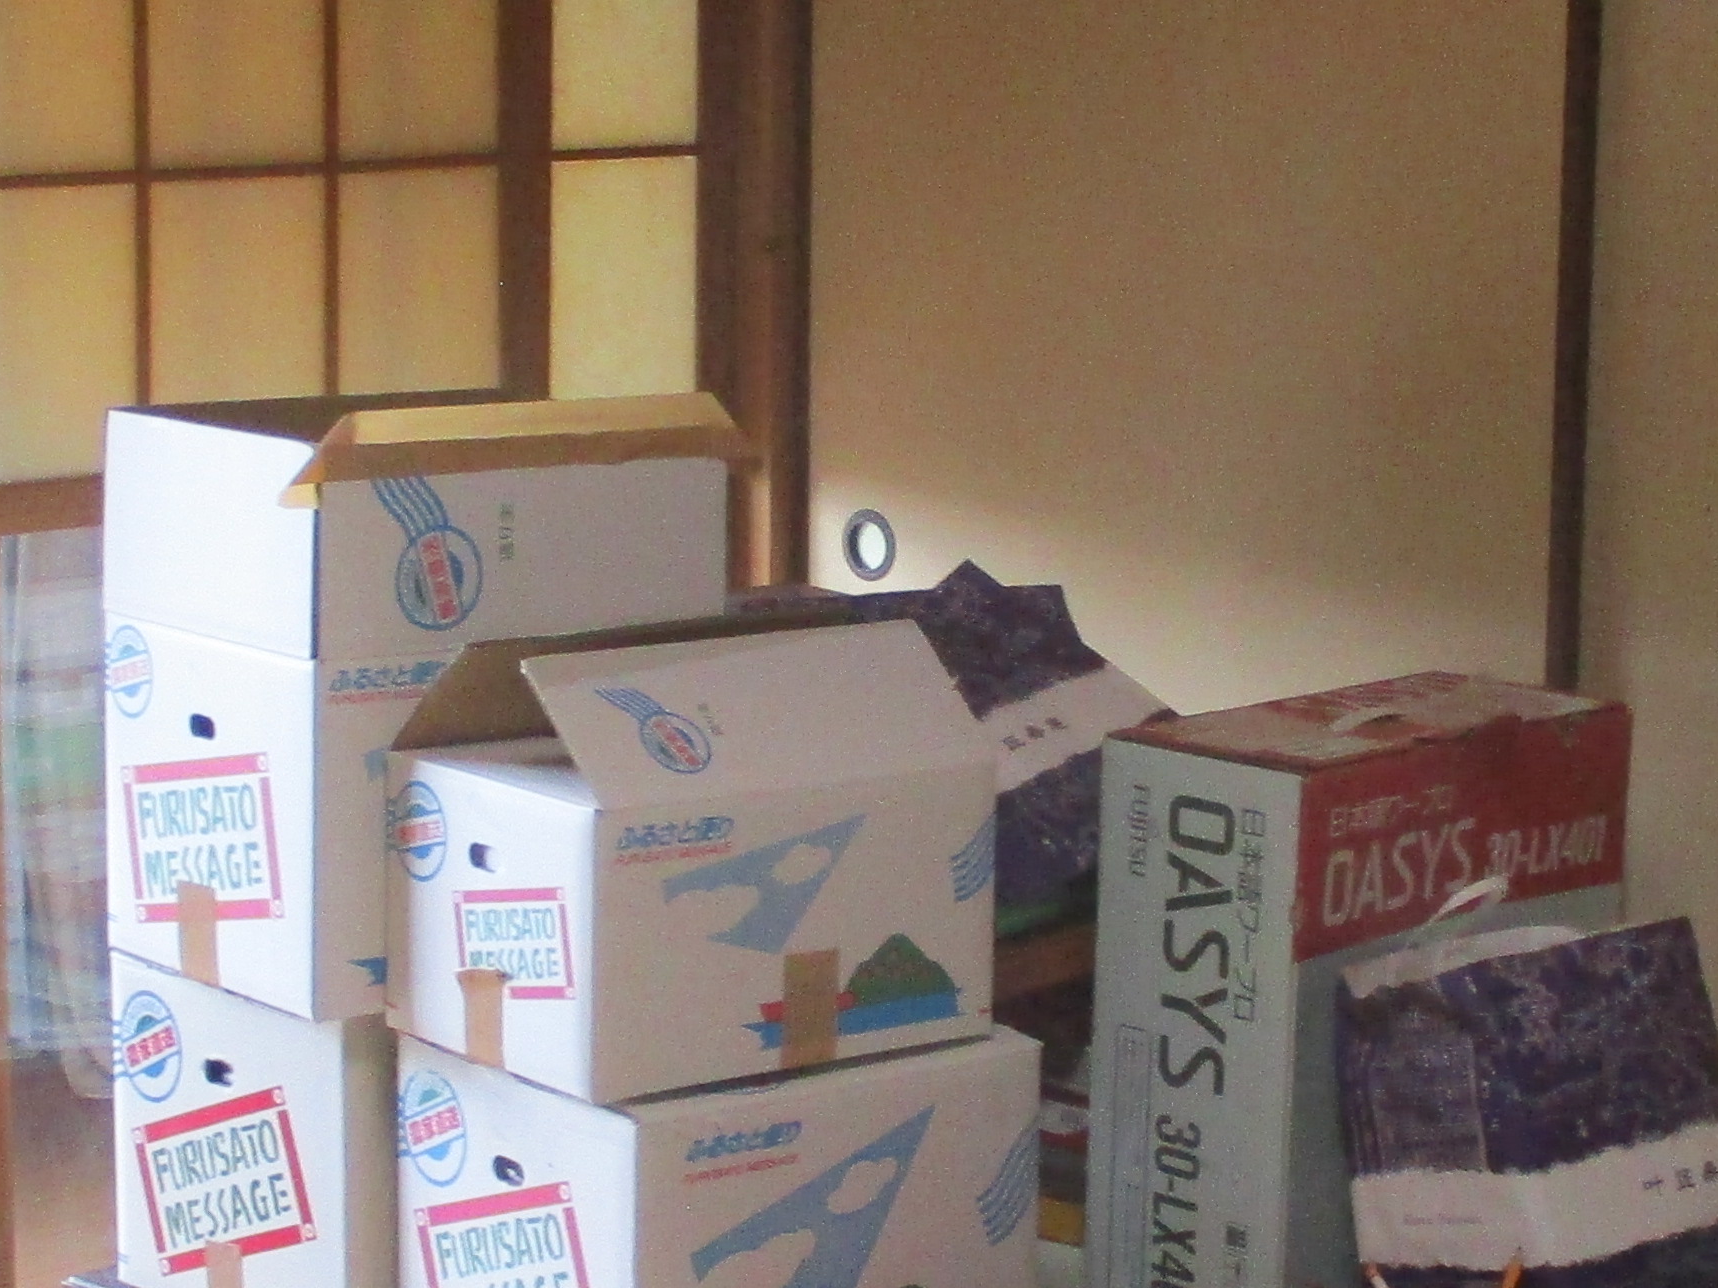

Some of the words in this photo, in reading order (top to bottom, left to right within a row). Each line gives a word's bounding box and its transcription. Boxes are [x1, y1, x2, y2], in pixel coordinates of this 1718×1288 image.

[138, 784, 257, 839] FURUSATO
[1129, 783, 1151, 878] FUJITSU
[144, 841, 263, 898] MESSAGE
[1322, 816, 1476, 927] OASYS
[1486, 814, 1608, 879] 30-LX401
[464, 908, 556, 943] FURUSATO
[1160, 795, 1235, 1096] OASYS
[152, 1119, 280, 1194] FURUSATO
[165, 1173, 292, 1249] MESSAGE
[435, 1213, 565, 1280] FURUSATO
